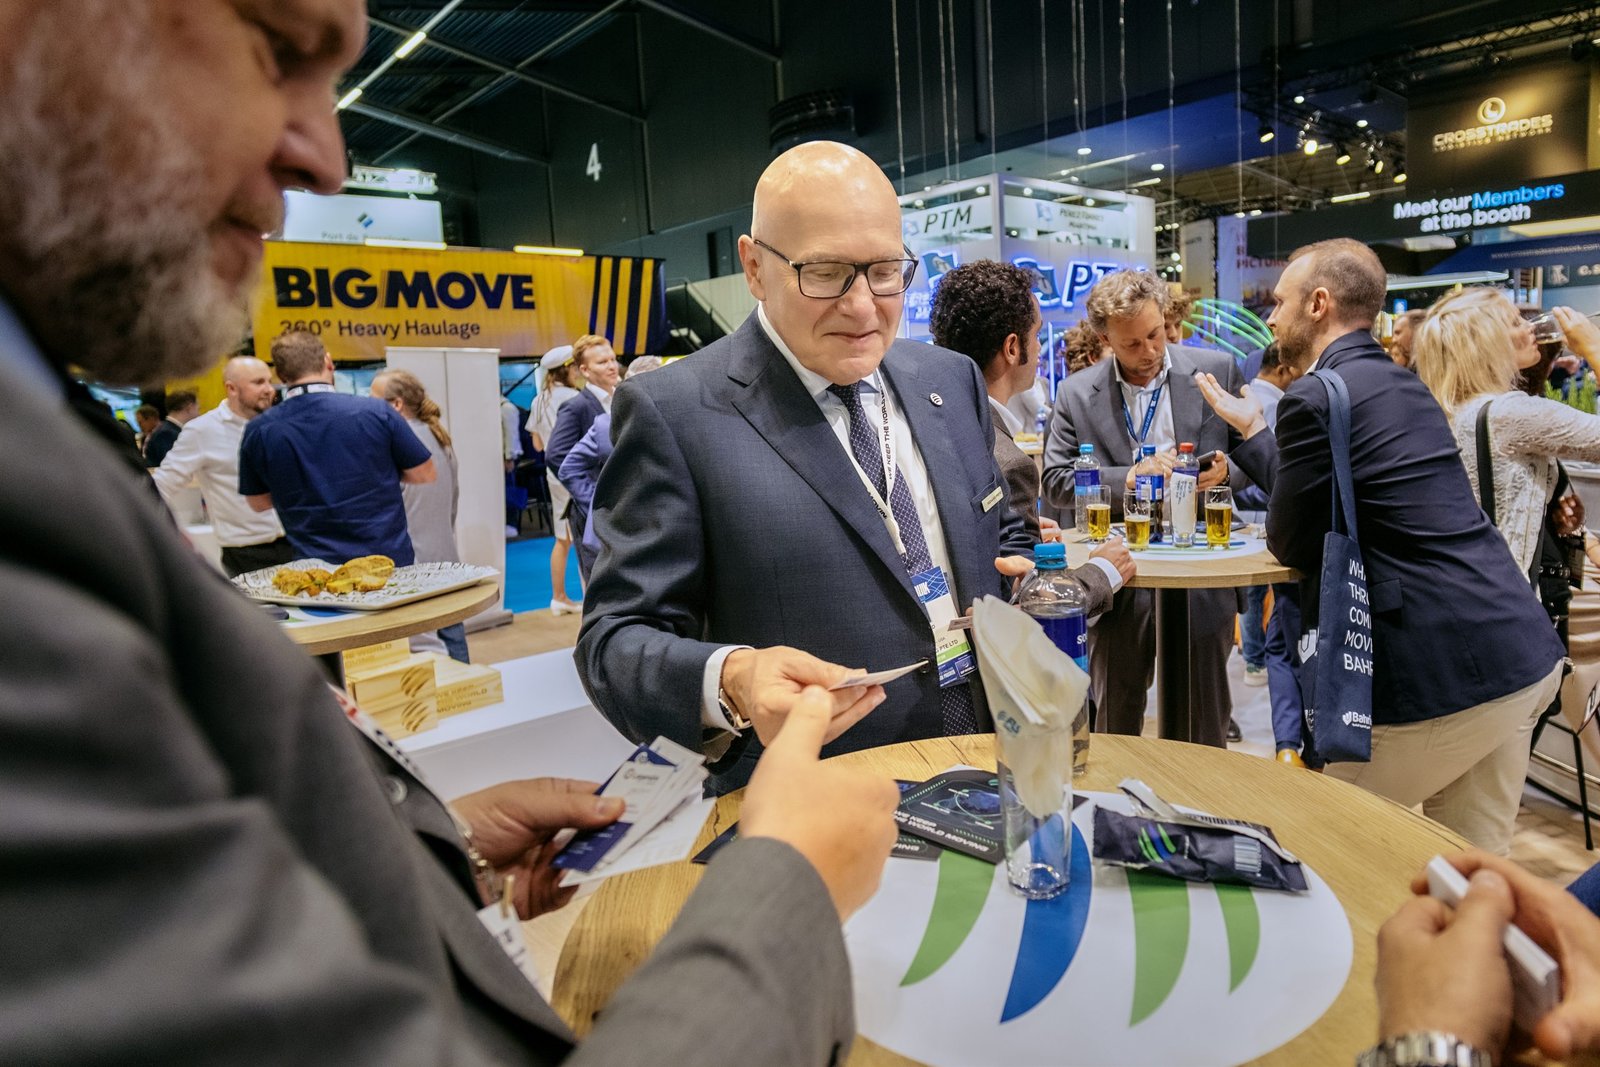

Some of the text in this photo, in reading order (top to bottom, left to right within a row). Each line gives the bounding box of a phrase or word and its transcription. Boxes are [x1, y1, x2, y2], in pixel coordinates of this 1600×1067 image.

[1433, 114, 1554, 146] CROSSTRADES
[585, 143, 602, 181] 4
[1393, 183, 1565, 220] Meet our Members
[924, 204, 973, 234] PTM
[1420, 203, 1531, 232] at the booth
[272, 266, 536, 310] BIG MOVE
[338, 320, 400, 340] Heavy
[406, 320, 481, 340] Haulage
[880, 399, 889, 425] WORLD
[883, 425, 891, 442] THE
[884, 443, 892, 465] KEEP
[939, 642, 949, 651] PTE
[949, 639, 959, 648] LTD
[1344, 629, 1373, 654] MOV
[909, 815, 937, 828] KEEP
[908, 820, 945, 836] WORLD
[944, 833, 990, 852] MOVING
